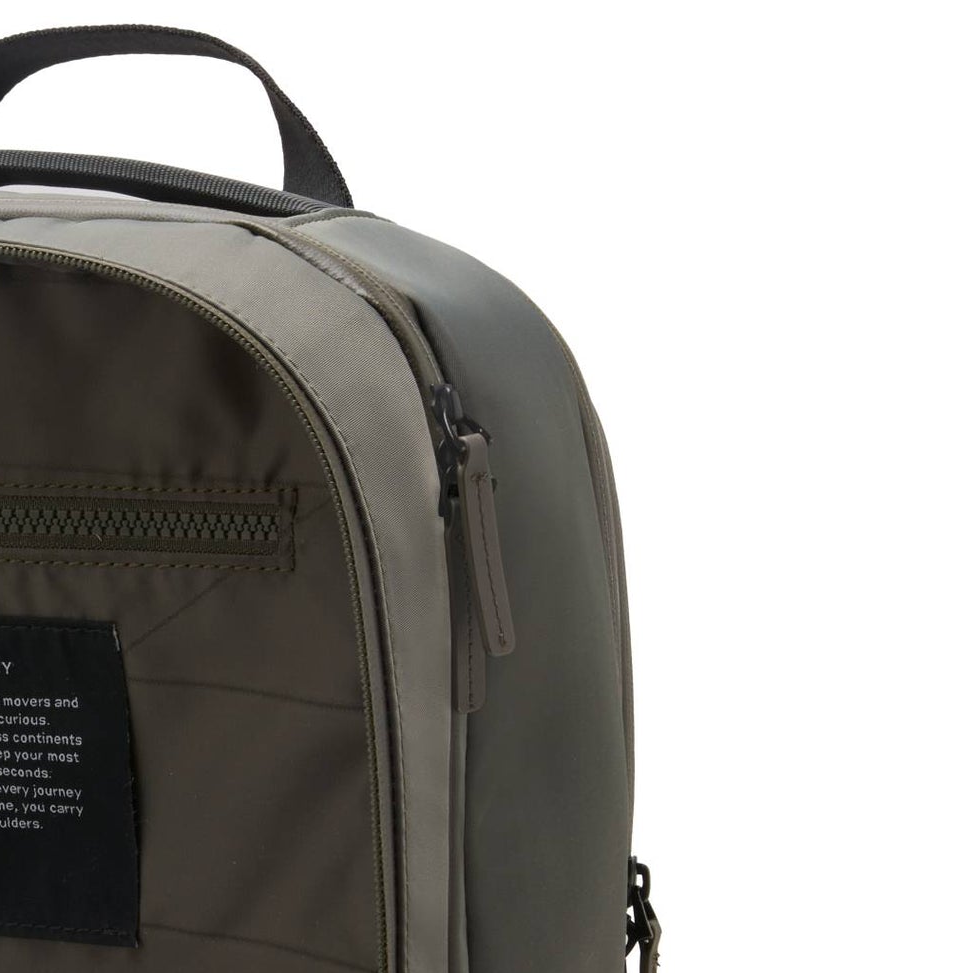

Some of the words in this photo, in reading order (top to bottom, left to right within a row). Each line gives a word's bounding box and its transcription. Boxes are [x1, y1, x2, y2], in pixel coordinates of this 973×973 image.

[2, 697, 51, 708] movers
[54, 696, 79, 709] and
[12, 731, 83, 746] continents
[14, 751, 43, 763] your
[47, 751, 80, 763] most
[33, 784, 82, 801] journey
[21, 803, 46, 814] you
[49, 804, 84, 817] carry
